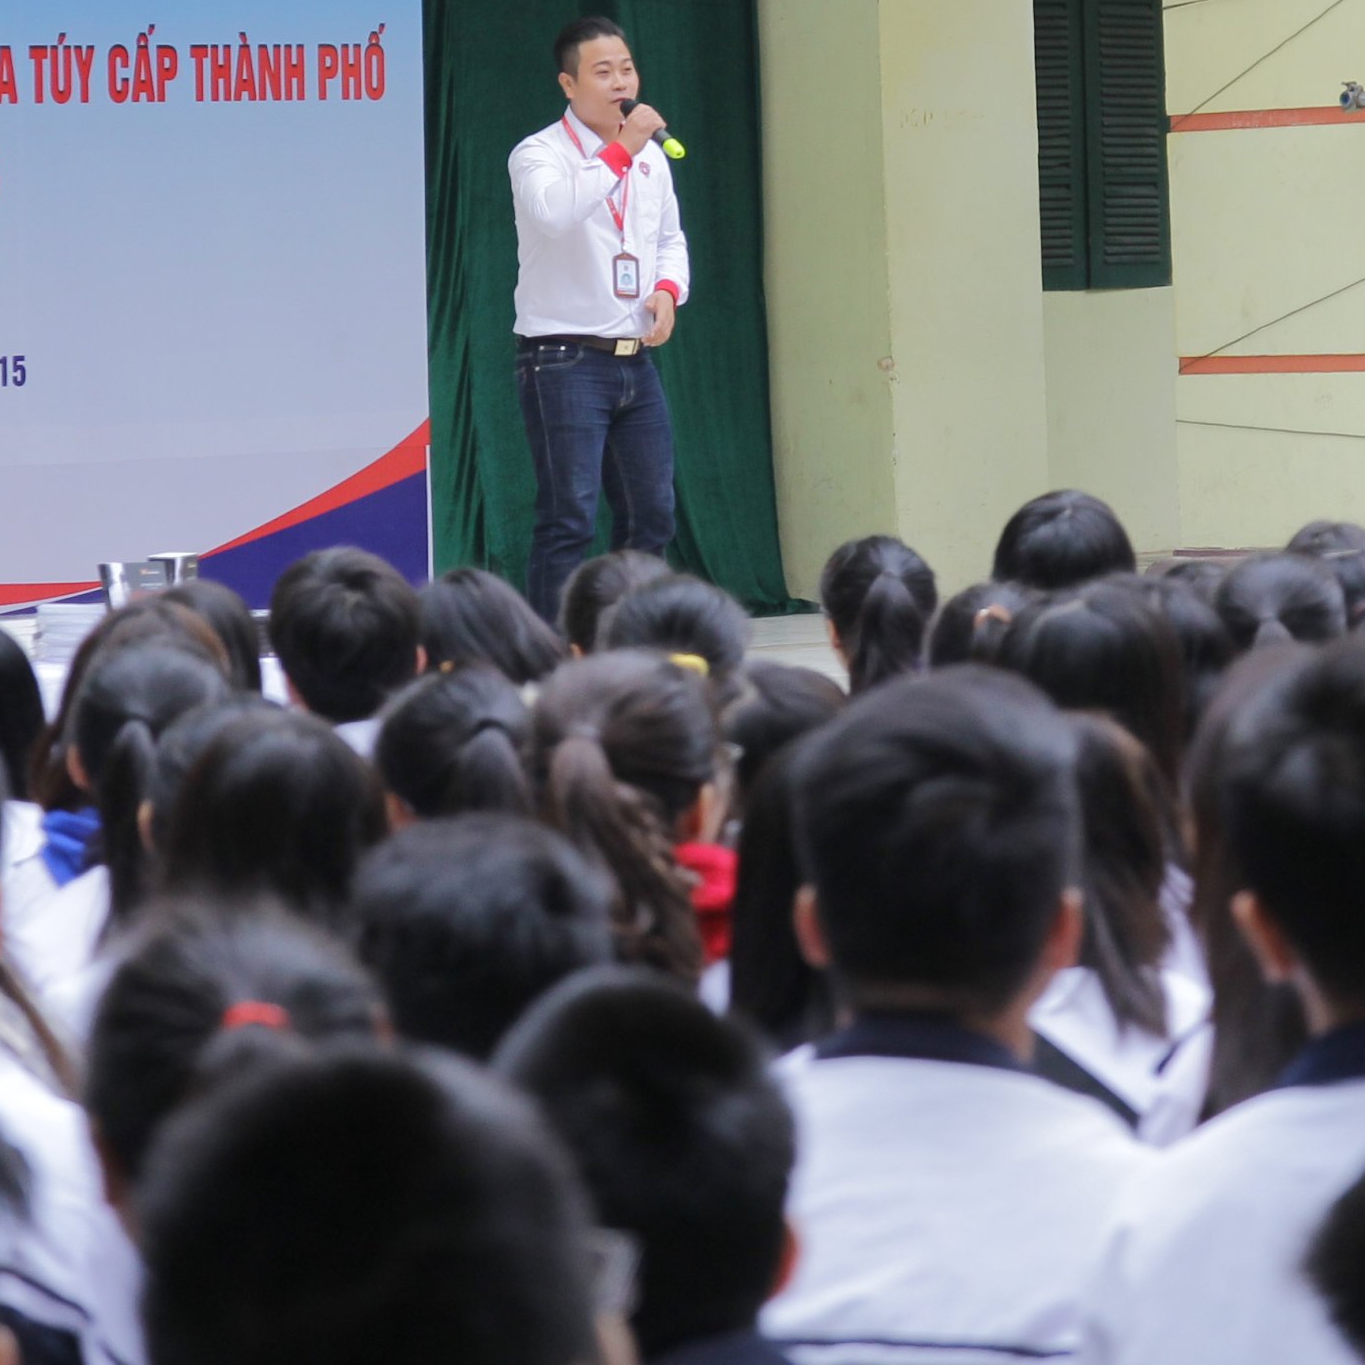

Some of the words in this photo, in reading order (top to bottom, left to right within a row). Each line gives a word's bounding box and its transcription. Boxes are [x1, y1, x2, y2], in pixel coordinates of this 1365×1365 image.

[28, 32, 95, 104] TÚY
[107, 23, 178, 104] CẤP
[189, 31, 306, 102] THÀNH
[317, 22, 386, 101] PHỐ
